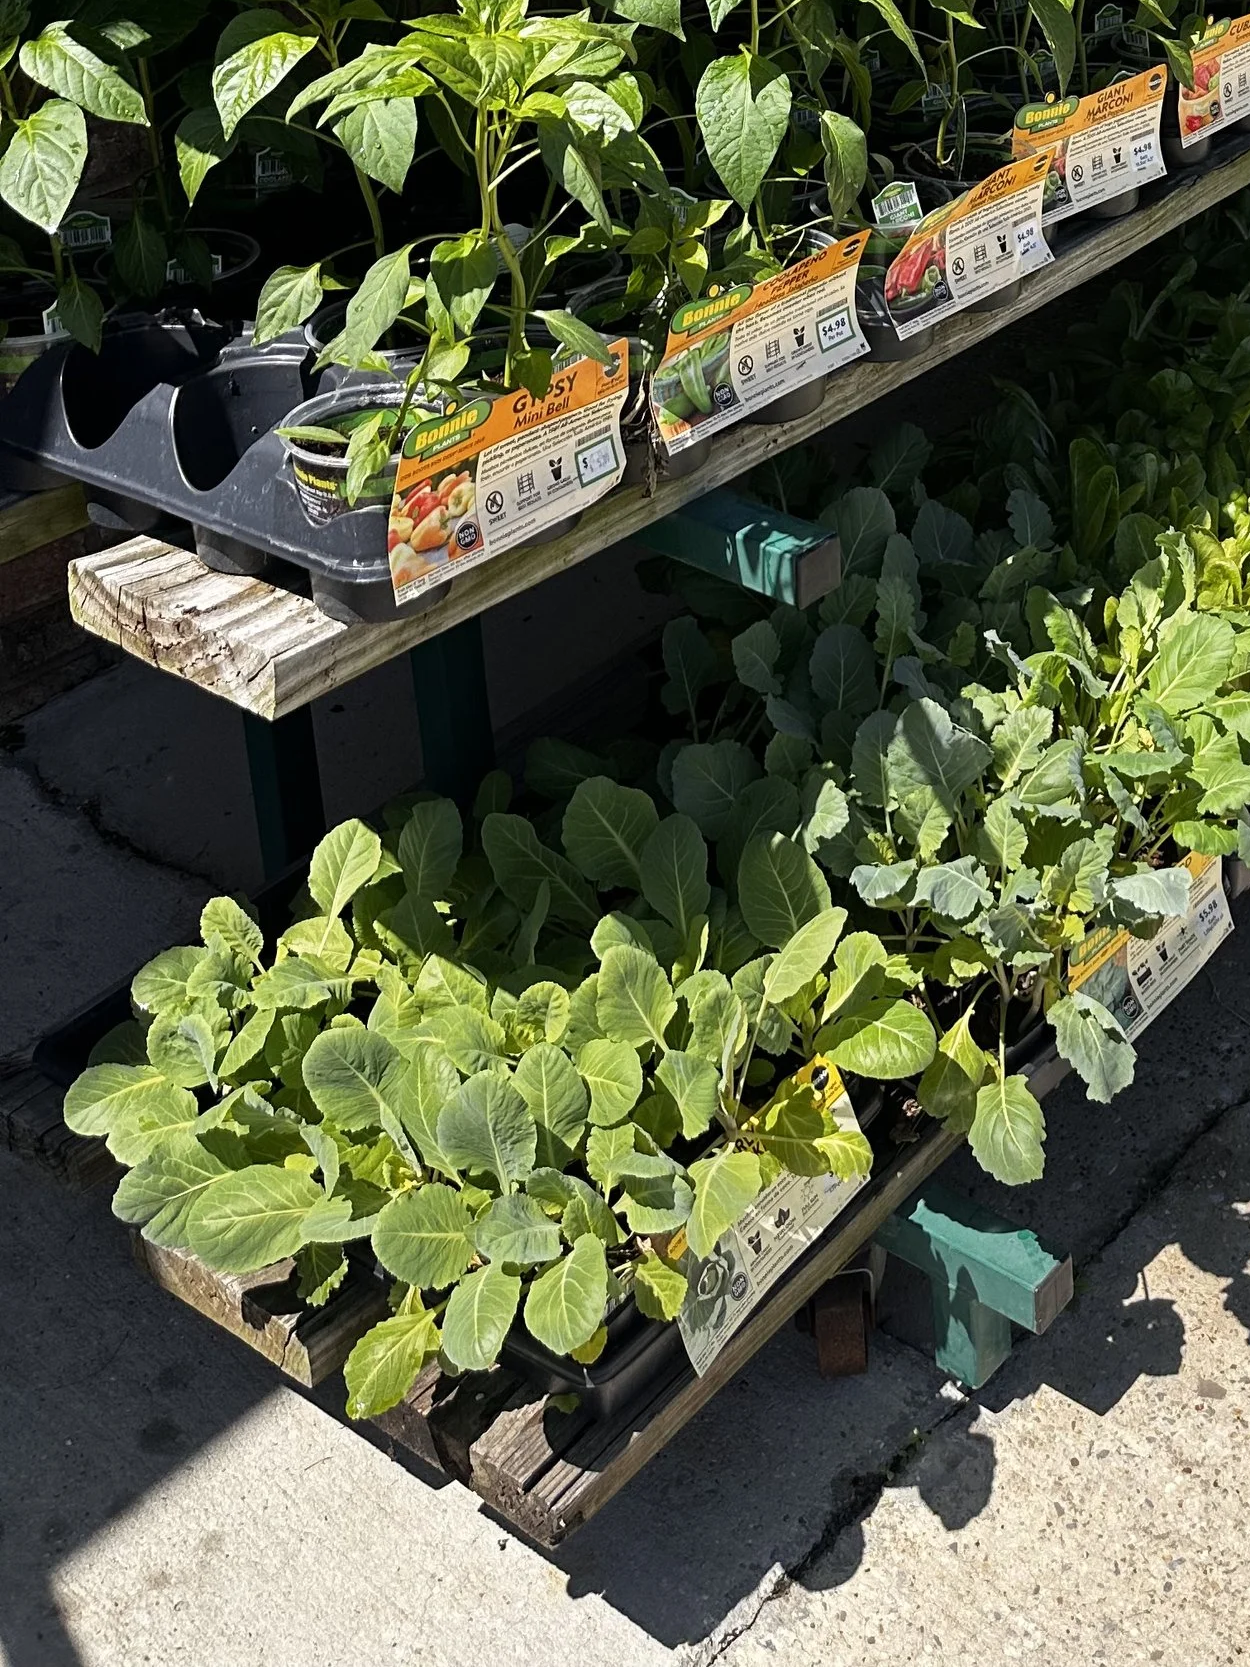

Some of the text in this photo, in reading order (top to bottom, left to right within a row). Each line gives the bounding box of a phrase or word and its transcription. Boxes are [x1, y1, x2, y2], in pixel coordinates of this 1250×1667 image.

[1097, 84, 1127, 104] GIANT
[1025, 102, 1071, 124] Bonnie
[1086, 91, 1134, 120] MARCONI
[1133, 142, 1152, 156] $4.98
[771, 269, 809, 295] PEPPER
[682, 292, 741, 327] Bonnie
[822, 317, 846, 336] $4.98
[716, 387, 730, 396] NON
[513, 396, 569, 430] Mini Bell
[415, 407, 479, 452] Bonnie
[432, 433, 461, 452] PLANTS
[459, 527, 475, 539] NON
[460, 534, 476, 545] GMO
[1199, 899, 1218, 922] $5.98
